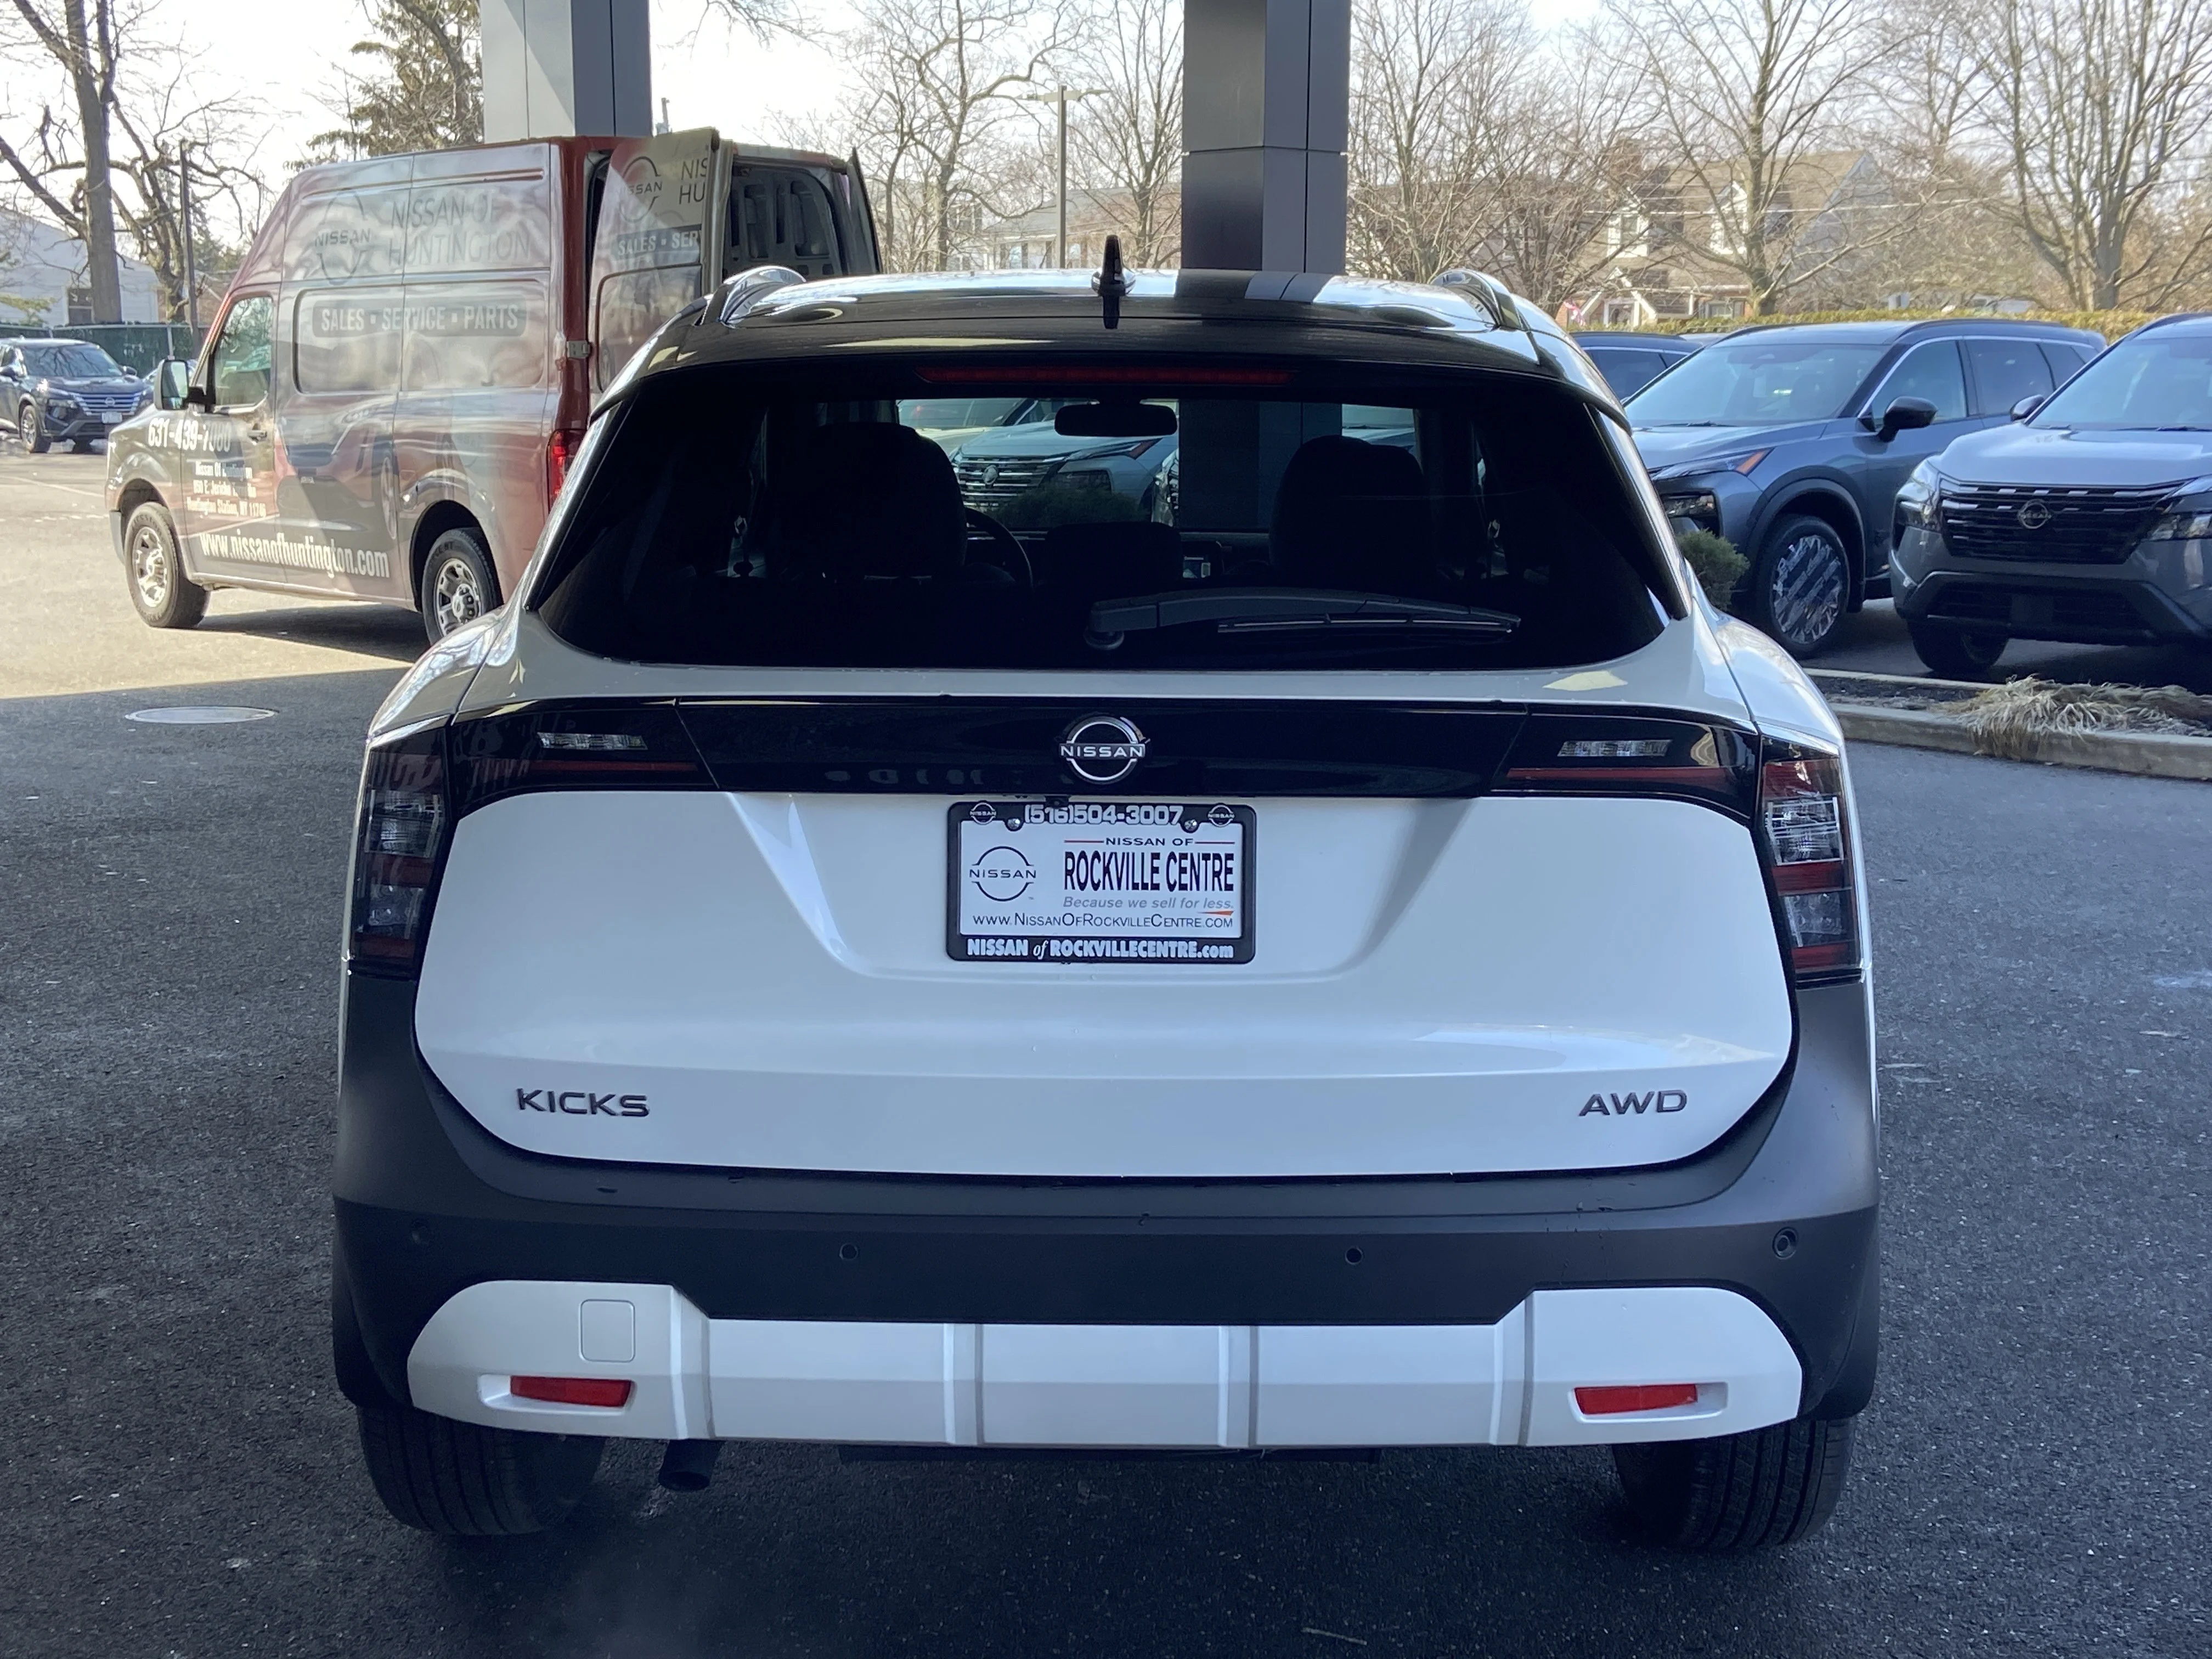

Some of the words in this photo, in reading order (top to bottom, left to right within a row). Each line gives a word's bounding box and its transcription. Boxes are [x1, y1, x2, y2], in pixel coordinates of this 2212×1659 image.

[392, 194, 465, 228] NISSAN
[314, 228, 371, 247] NISSAN
[389, 230, 531, 266] HUNTINGTON
[618, 236, 656, 256] SALES
[321, 307, 364, 331] SALES
[382, 306, 446, 330] SERVICE
[464, 304, 518, 329] PARTS
[199, 528, 390, 579] www.nissanofhuntington.com
[1060, 746, 1143, 758] NISSAN
[1024, 804, 1184, 825] (516)504-3007
[1105, 837, 1165, 846] NISSAN
[1172, 838, 1193, 846] OF
[969, 869, 1036, 878] NISSAN
[1064, 850, 1161, 891] ROCKVILLE
[1166, 851, 1234, 892] CENTRE
[1063, 896, 1123, 908] Because
[1127, 899, 1147, 908] we
[1152, 897, 1176, 909] sell
[1180, 897, 1200, 911] for
[1203, 897, 1234, 909] less.
[967, 938, 1029, 956] NISSAN
[1032, 940, 1049, 960] of
[1049, 939, 1234, 958] ROCKVILLECENTRE.com
[516, 1088, 650, 1117] KICKS
[1578, 1090, 1688, 1116] AWD
